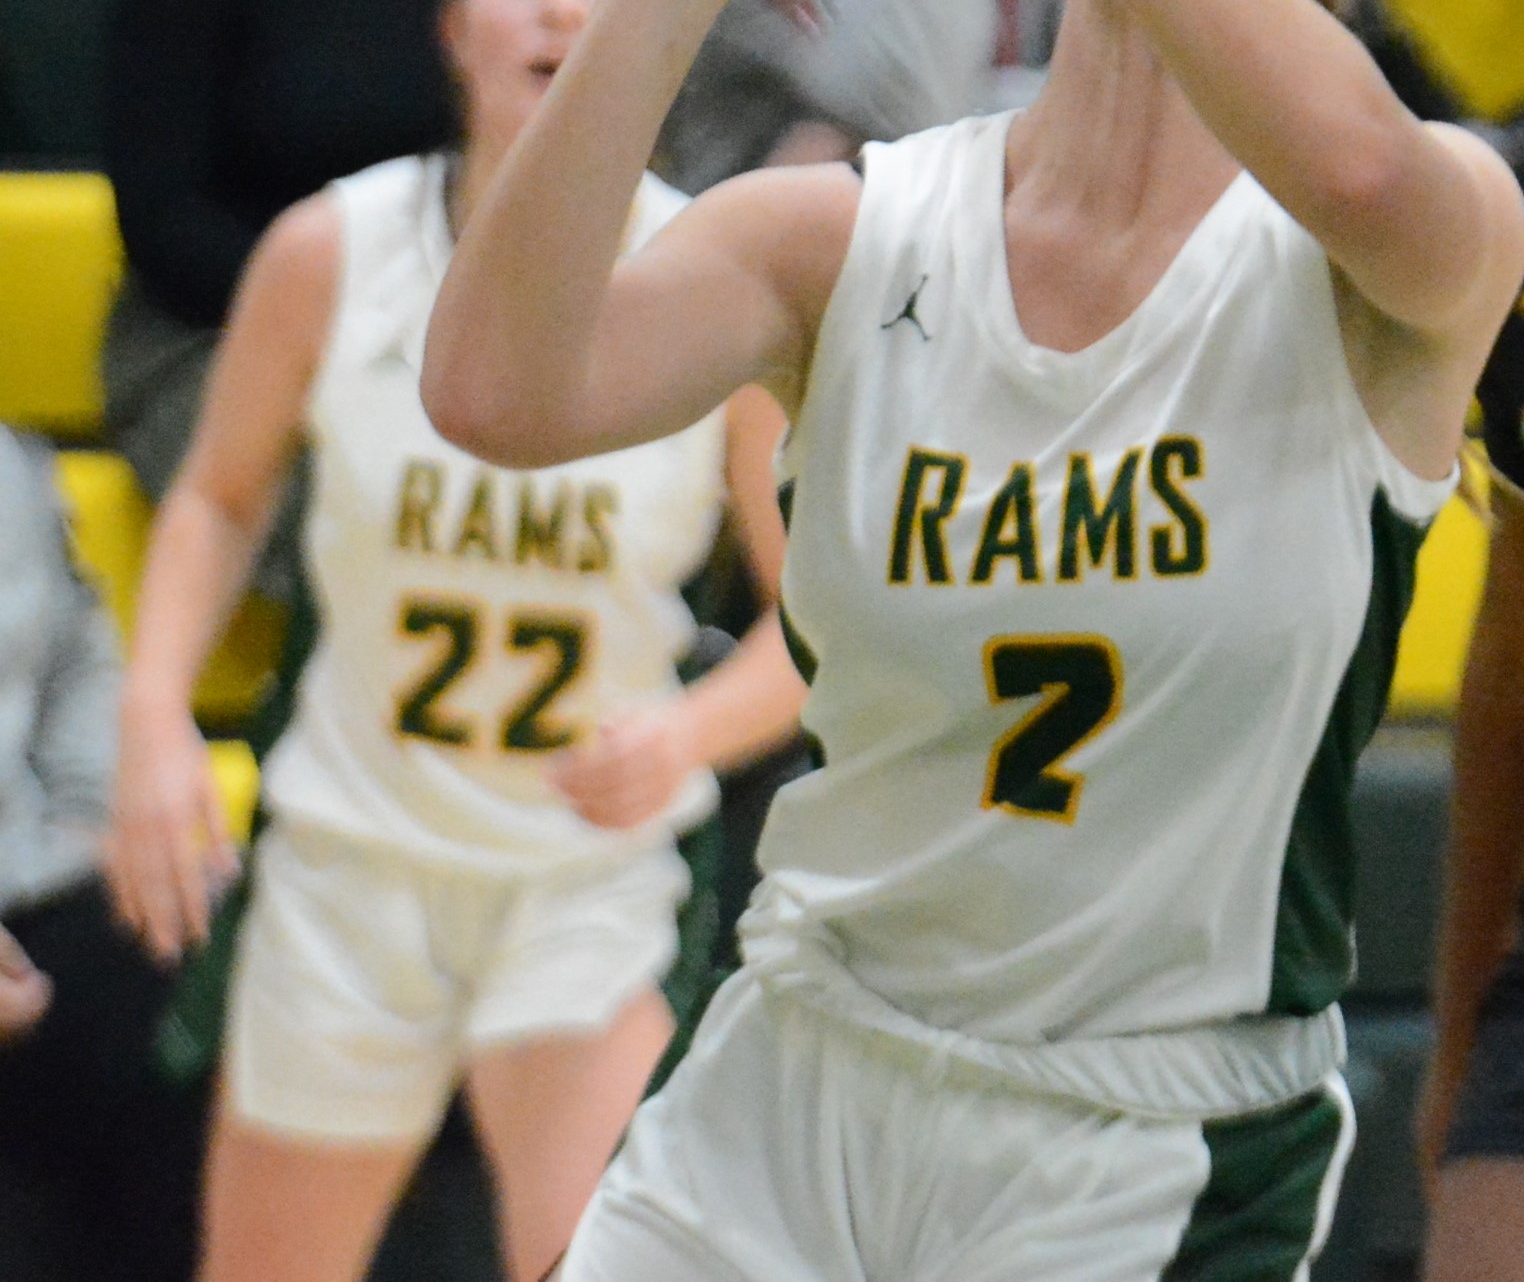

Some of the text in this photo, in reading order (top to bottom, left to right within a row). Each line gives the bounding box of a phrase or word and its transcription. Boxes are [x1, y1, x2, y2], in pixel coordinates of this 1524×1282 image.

[392, 455, 622, 575] RAMS
[887, 432, 1211, 587] RAMS
[390, 587, 597, 752] 22
[980, 631, 1124, 827] 2
